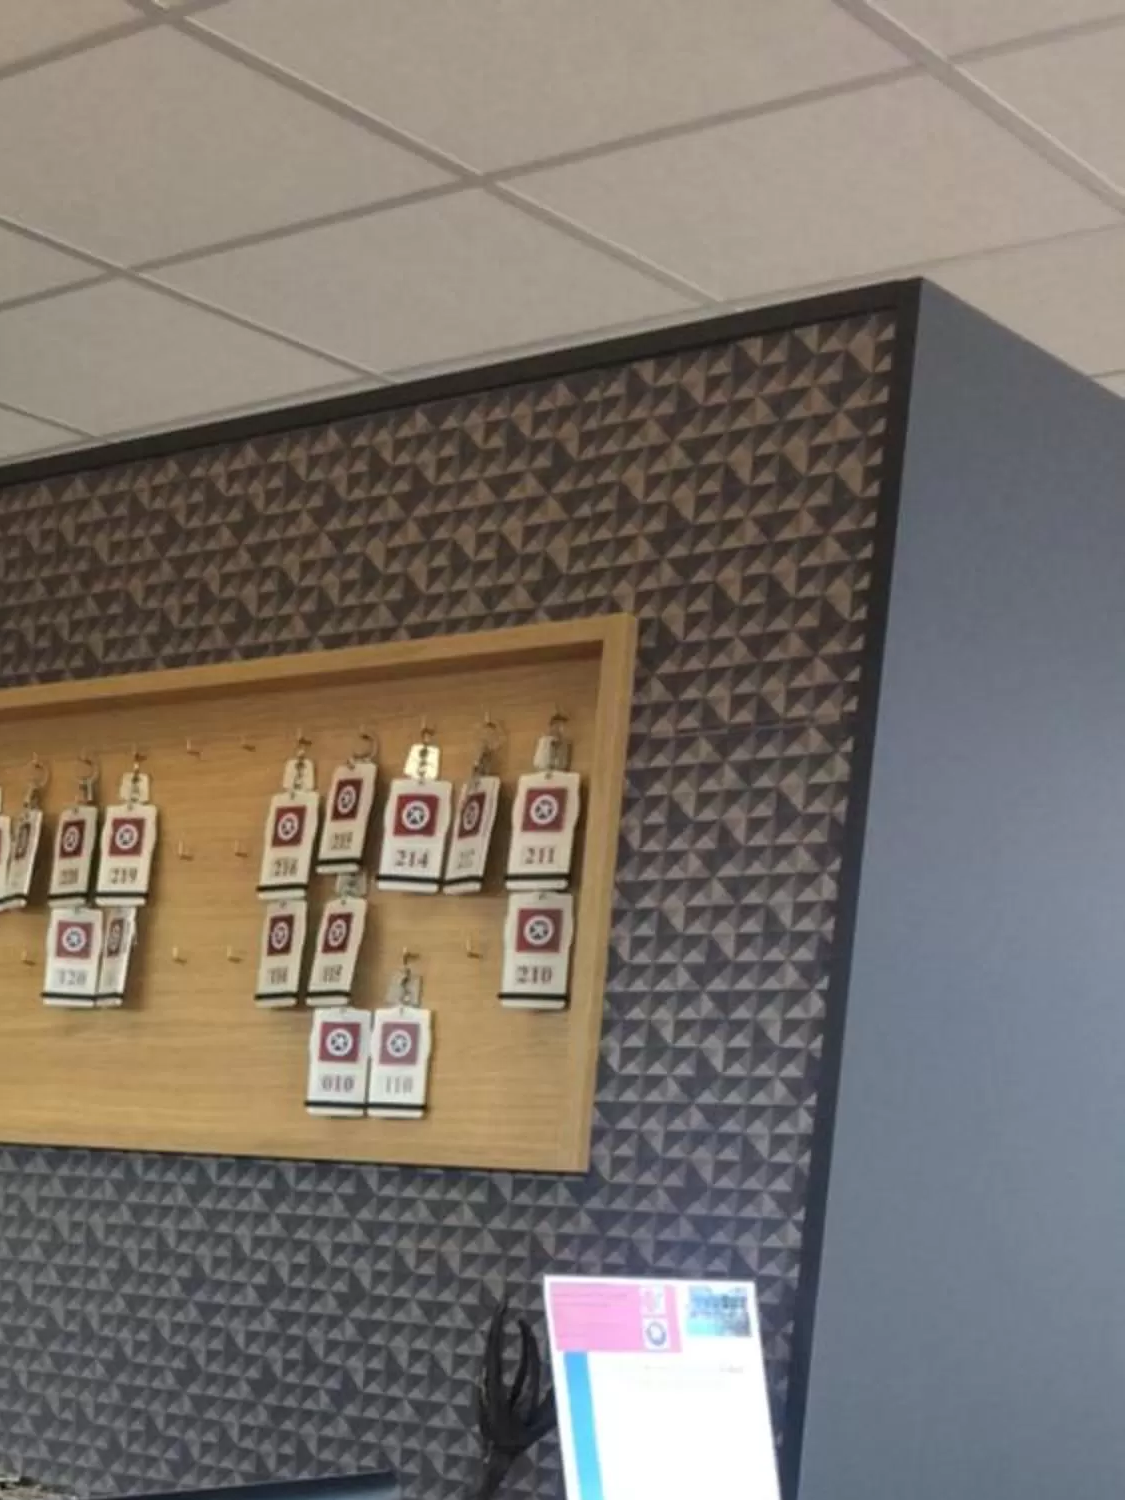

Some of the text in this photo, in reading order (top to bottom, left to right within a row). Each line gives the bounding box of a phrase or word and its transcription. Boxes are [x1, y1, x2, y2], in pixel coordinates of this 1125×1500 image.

[395, 848, 429, 868] 214
[525, 846, 556, 865] 211
[517, 965, 552, 984] 210
[321, 1075, 355, 1092] 010
